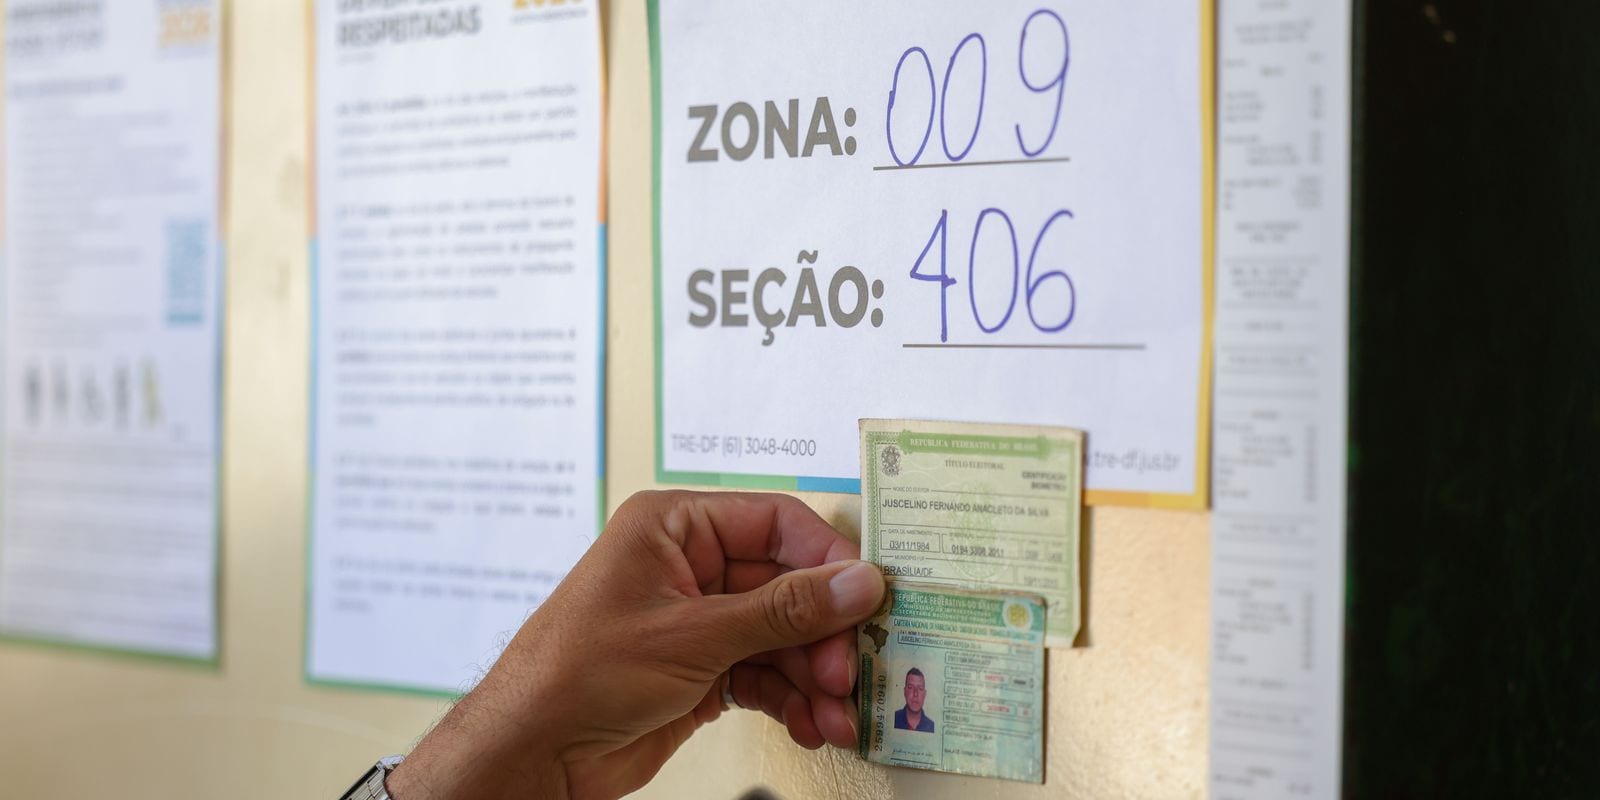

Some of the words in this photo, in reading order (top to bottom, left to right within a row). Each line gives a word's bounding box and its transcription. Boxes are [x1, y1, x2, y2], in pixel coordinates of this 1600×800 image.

[337, 5, 482, 46] RESPEITADAS
[886, 8, 1070, 167] 009
[687, 96, 858, 163] ZONA:
[687, 249, 885, 347] SEÇÃO:
[910, 207, 1076, 342] 406
[671, 433, 720, 454] TRE-DF
[745, 437, 817, 457] 3048-4000
[1084, 449, 1182, 475] .tre-df.jus.br
[882, 498, 928, 510] JUSCELINO
[929, 500, 971, 513] FERNANDO
[971, 503, 1013, 515] ANACLETO
[1015, 506, 1026, 515] DA
